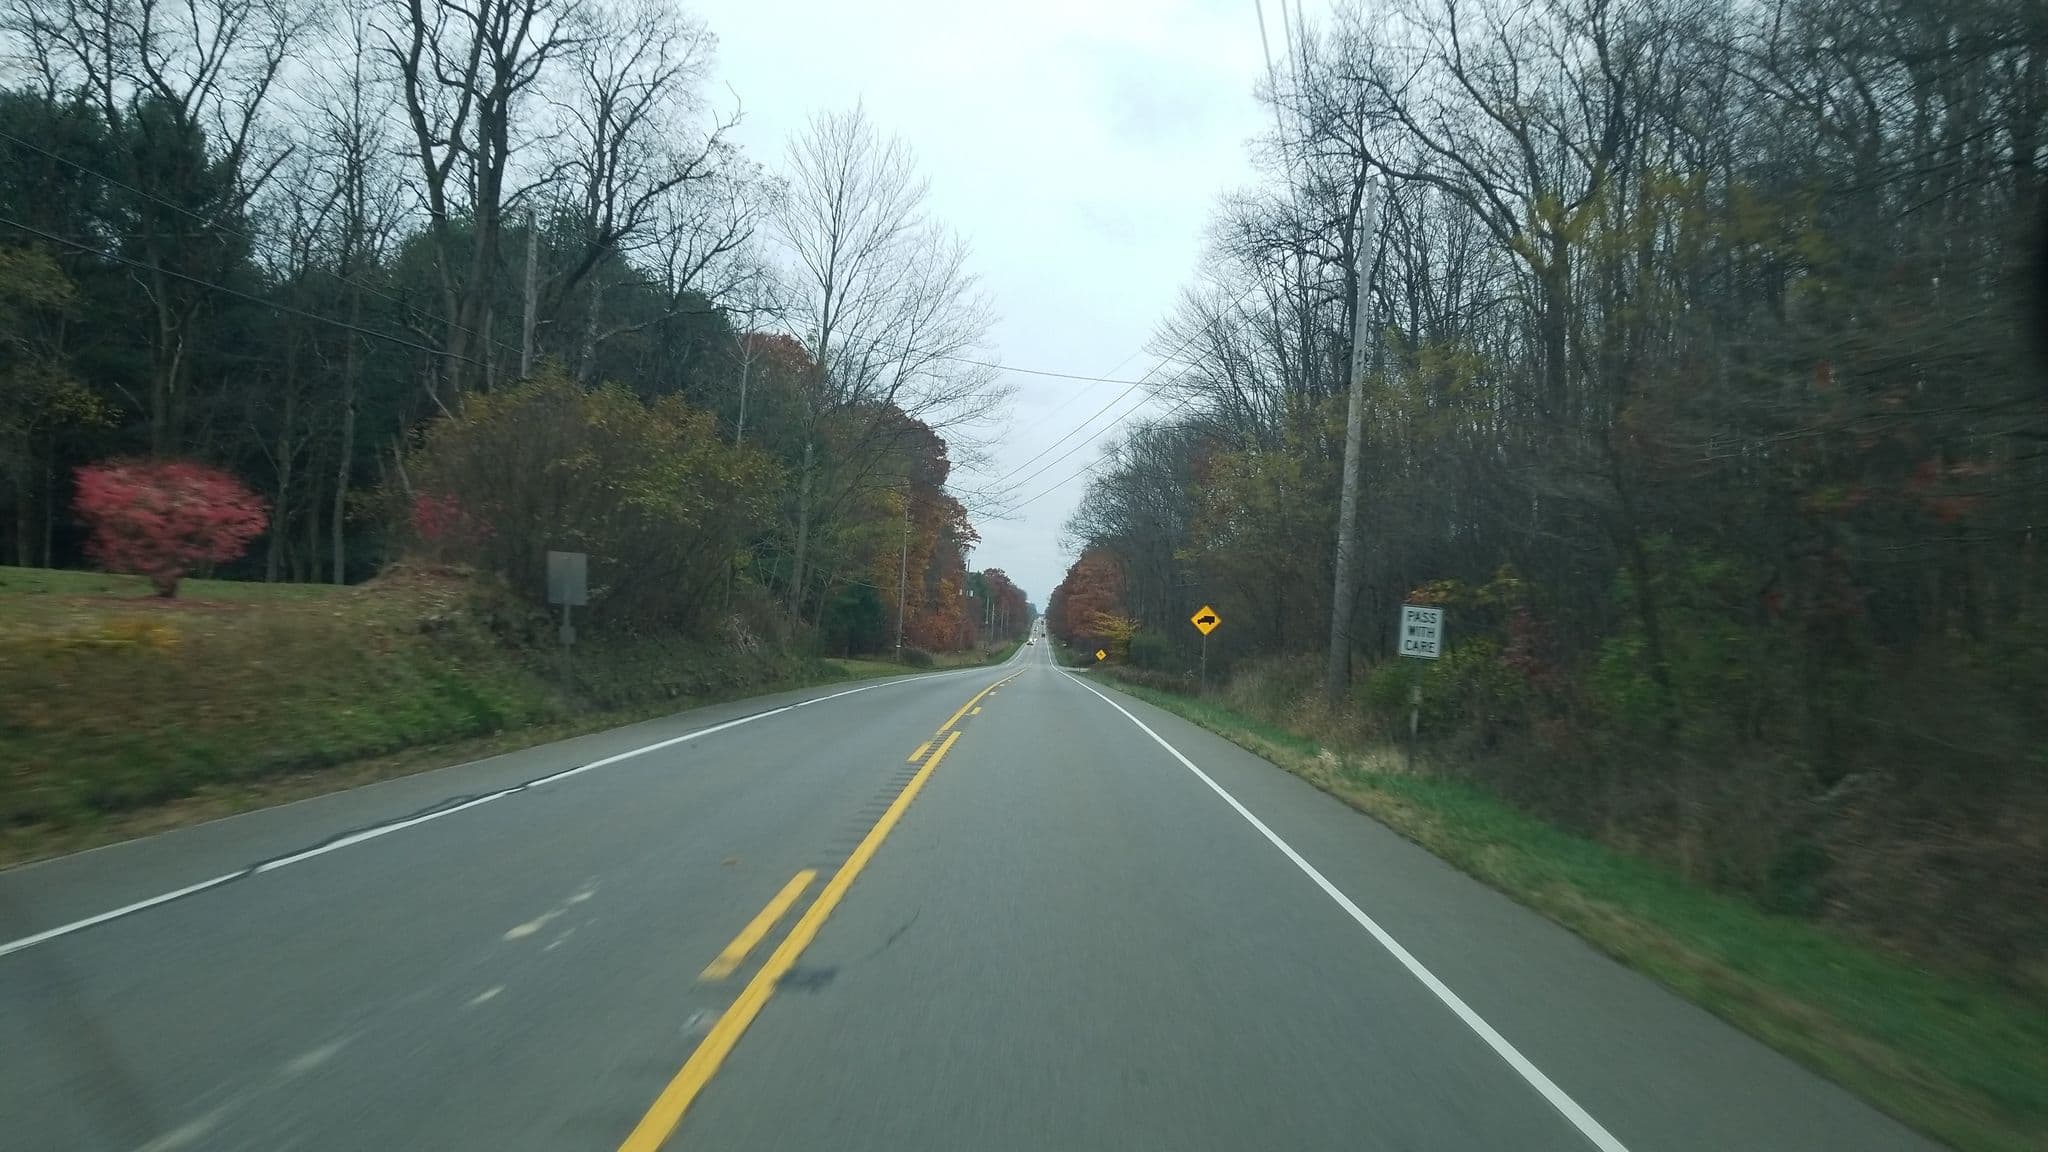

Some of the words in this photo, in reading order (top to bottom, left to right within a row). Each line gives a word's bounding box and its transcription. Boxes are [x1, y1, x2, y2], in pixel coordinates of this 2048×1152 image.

[1408, 610, 1438, 624] PASS
[1408, 625, 1435, 639] WITH
[1406, 639, 1435, 654] CARE
